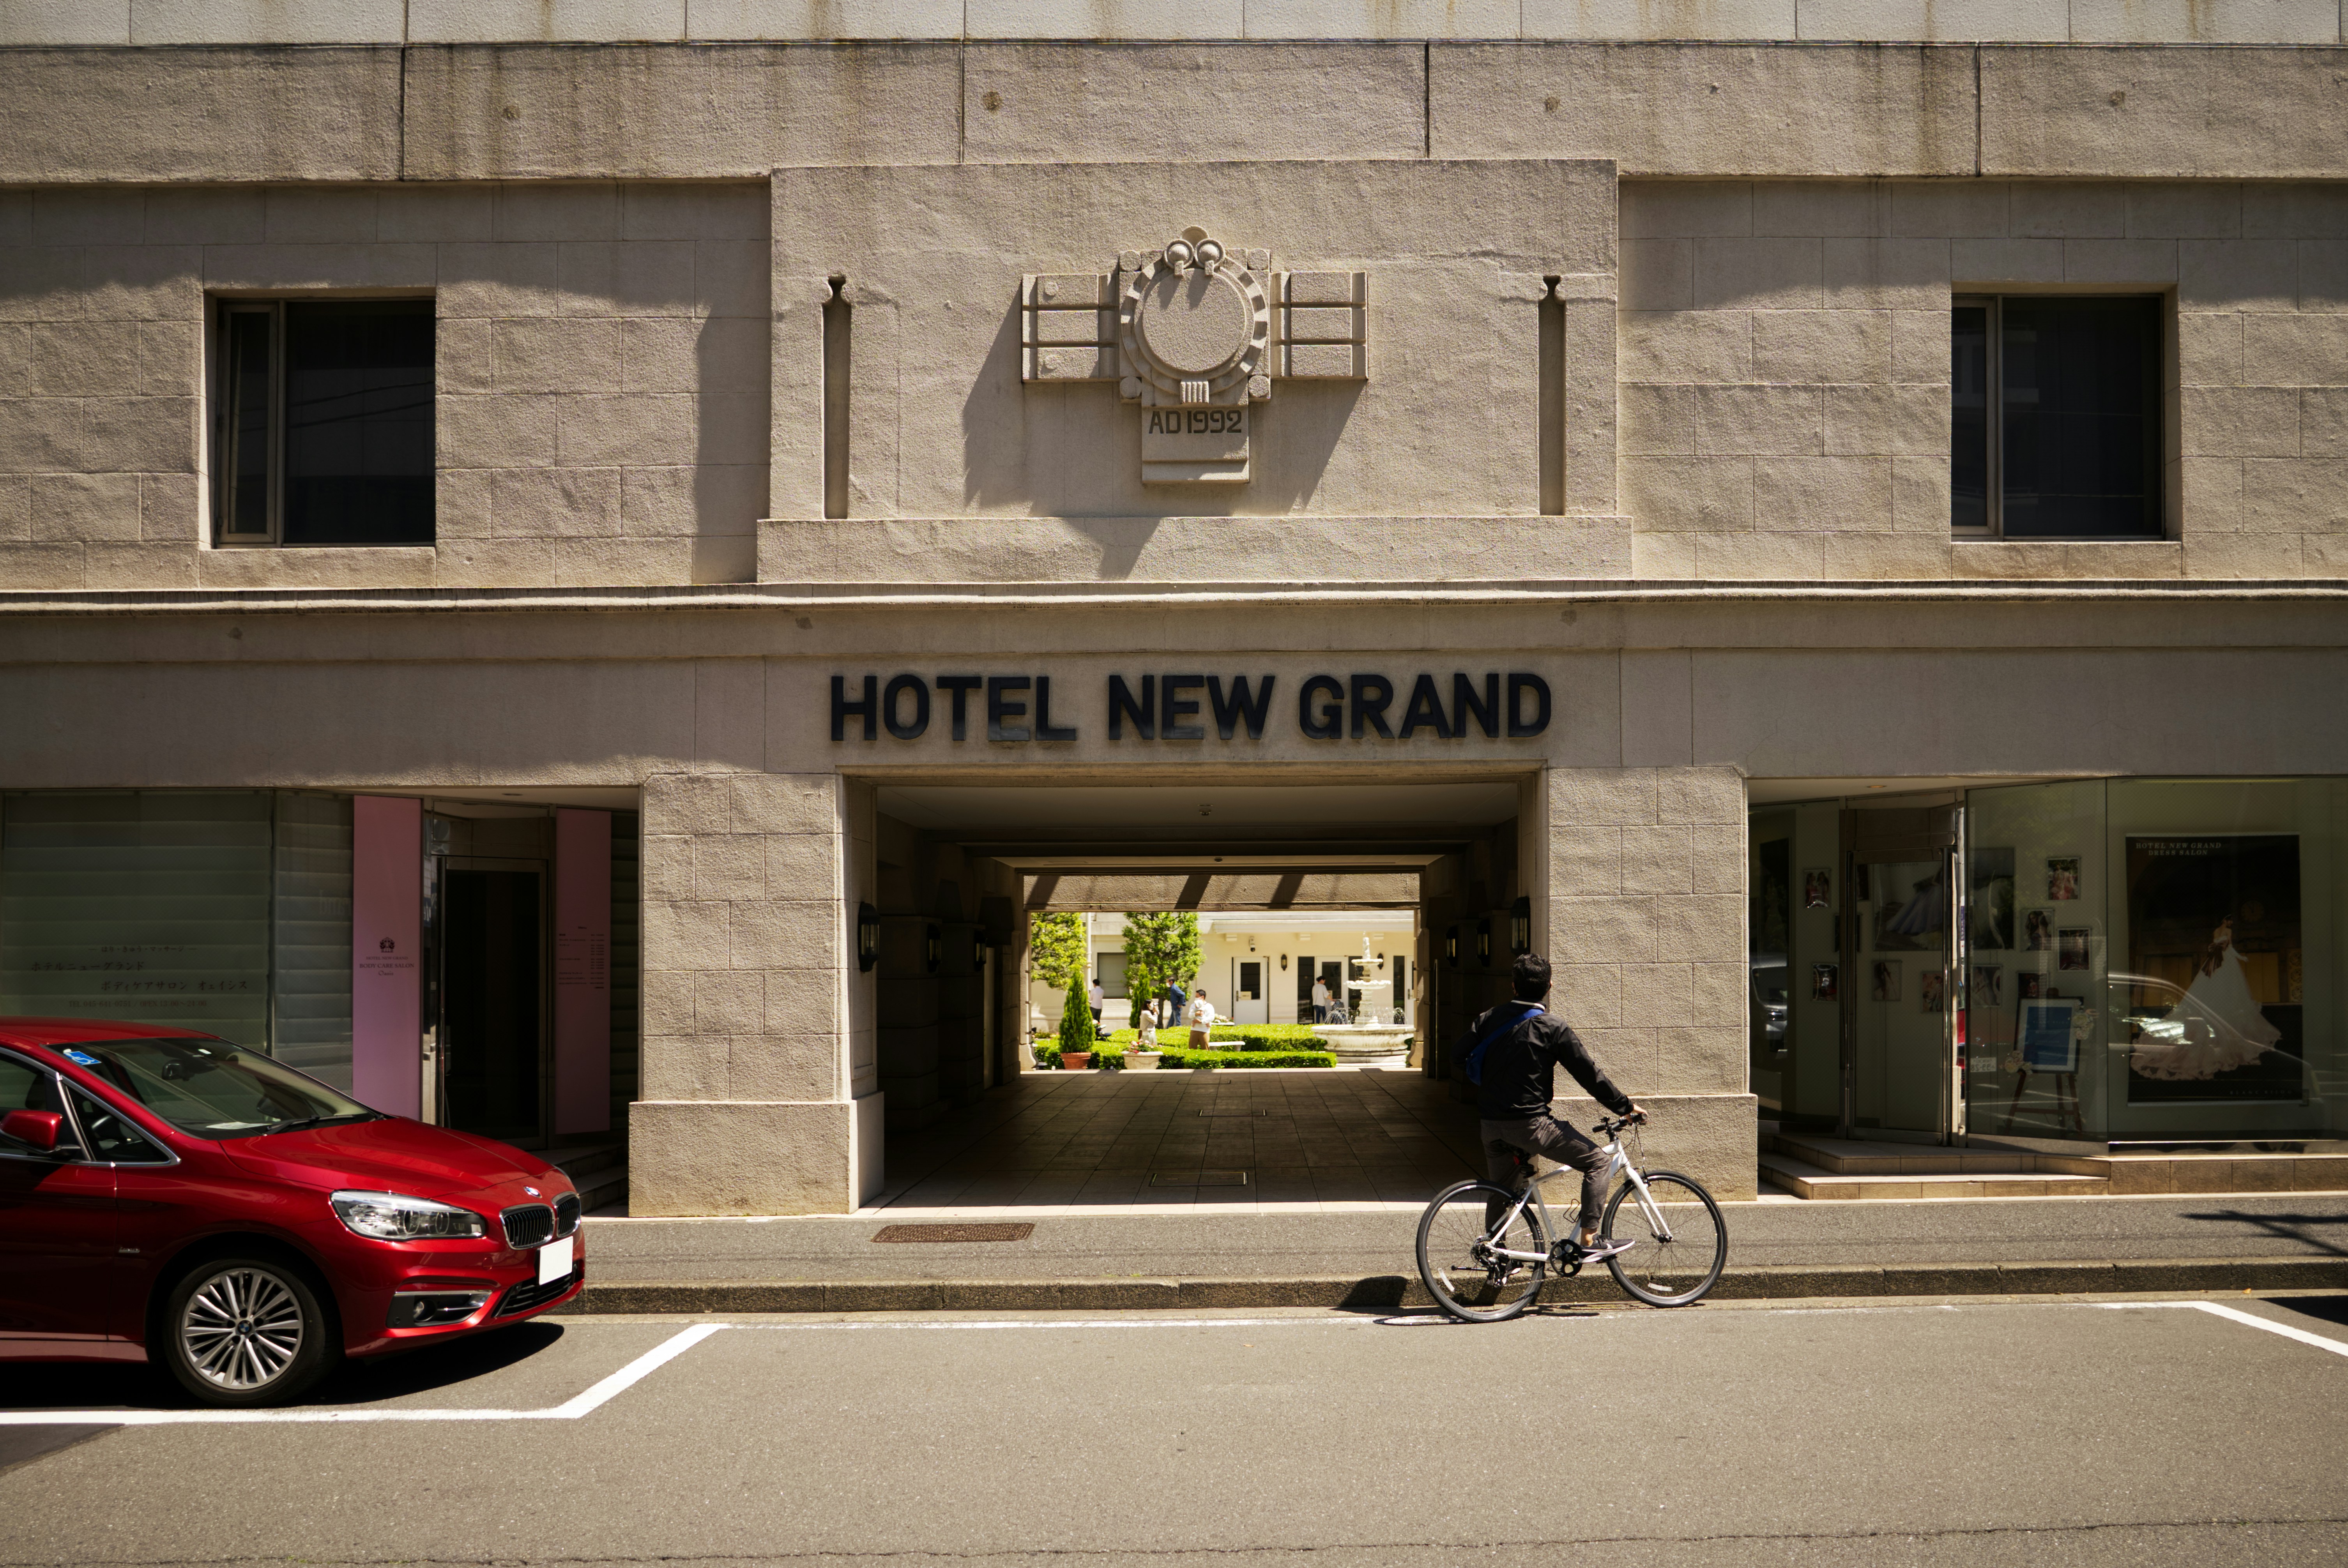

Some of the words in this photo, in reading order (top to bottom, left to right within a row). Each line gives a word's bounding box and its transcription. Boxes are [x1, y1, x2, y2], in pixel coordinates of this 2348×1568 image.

[1149, 410, 1181, 434] AD
[1187, 410, 1241, 434] 1992
[831, 675, 1076, 742] HOTEL
[1108, 675, 1276, 741] NEW
[1299, 673, 1552, 740] GRAND
[32, 962, 144, 971] ホテルニューグランド
[101, 981, 187, 991] ボディケアサロン
